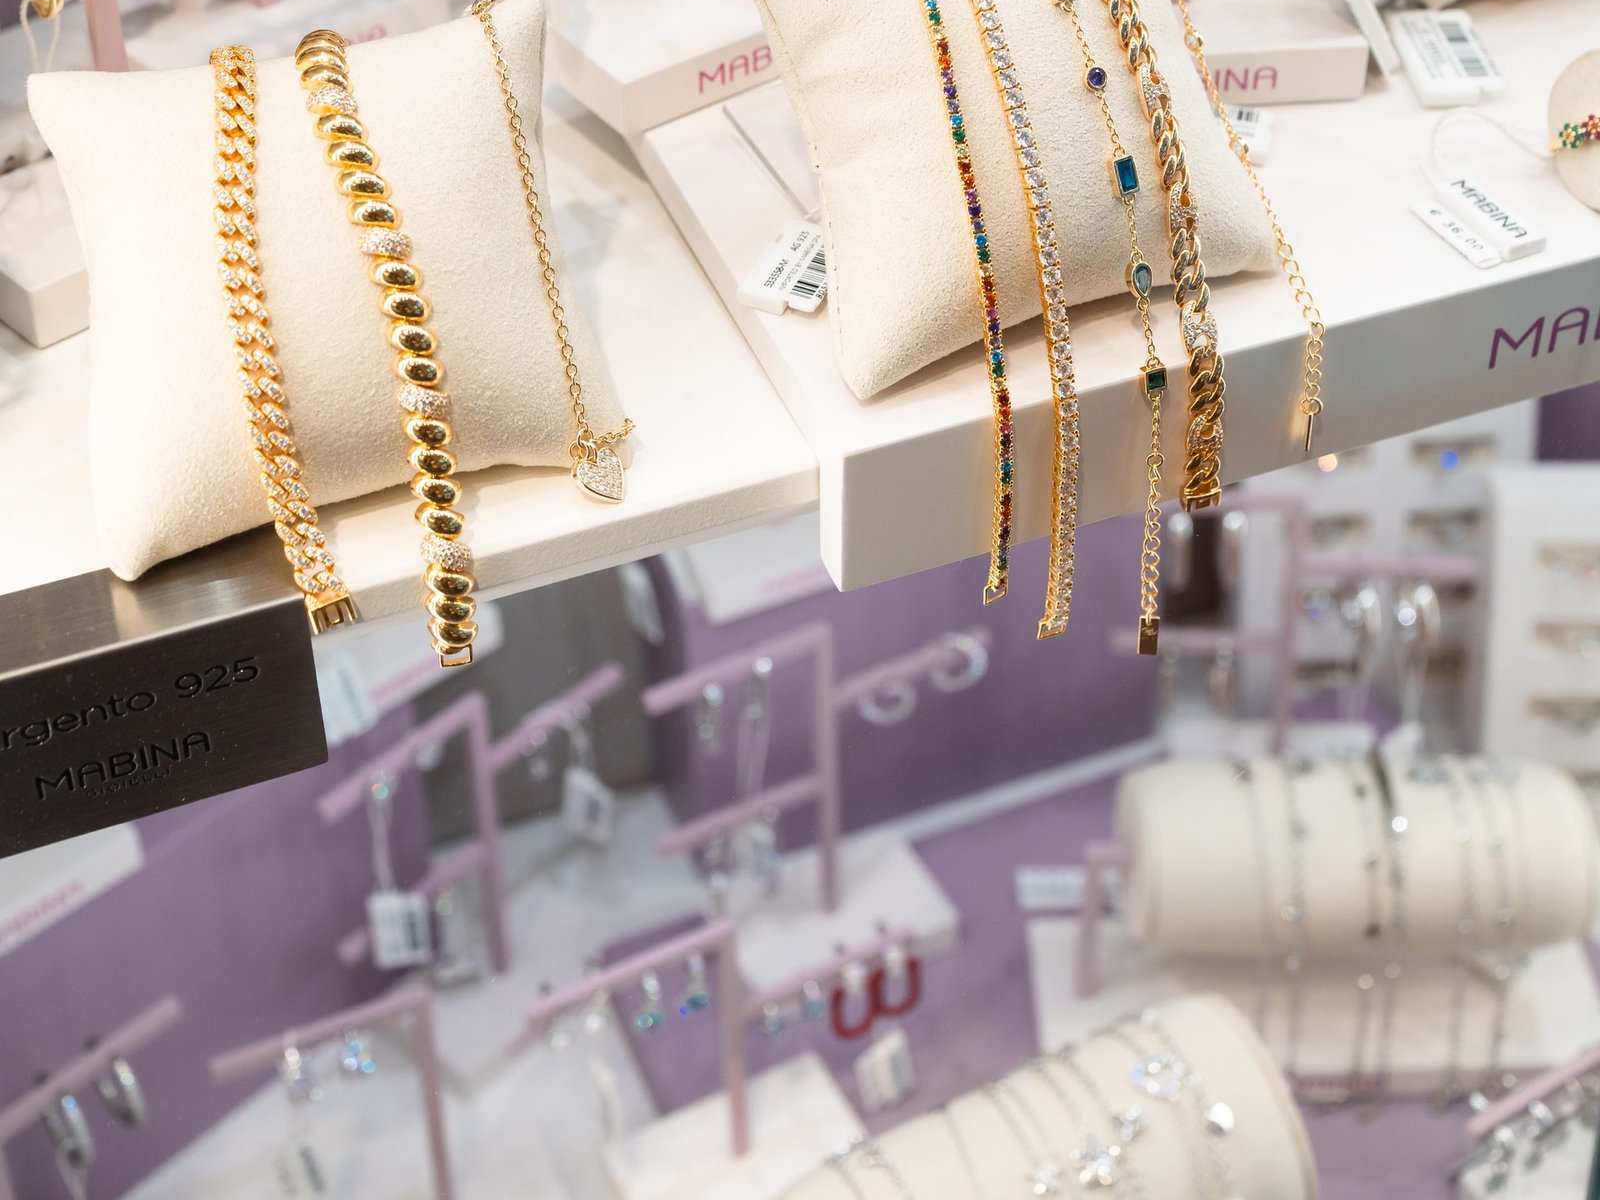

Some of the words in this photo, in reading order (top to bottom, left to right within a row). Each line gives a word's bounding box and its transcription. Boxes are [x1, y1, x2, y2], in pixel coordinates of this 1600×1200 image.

[1450, 179, 1528, 239] MABINA
[1487, 306, 1600, 370] MA
[174, 655, 260, 699] 925
[35, 731, 212, 801] MABINA
[85, 768, 171, 800] GIOIELLI
